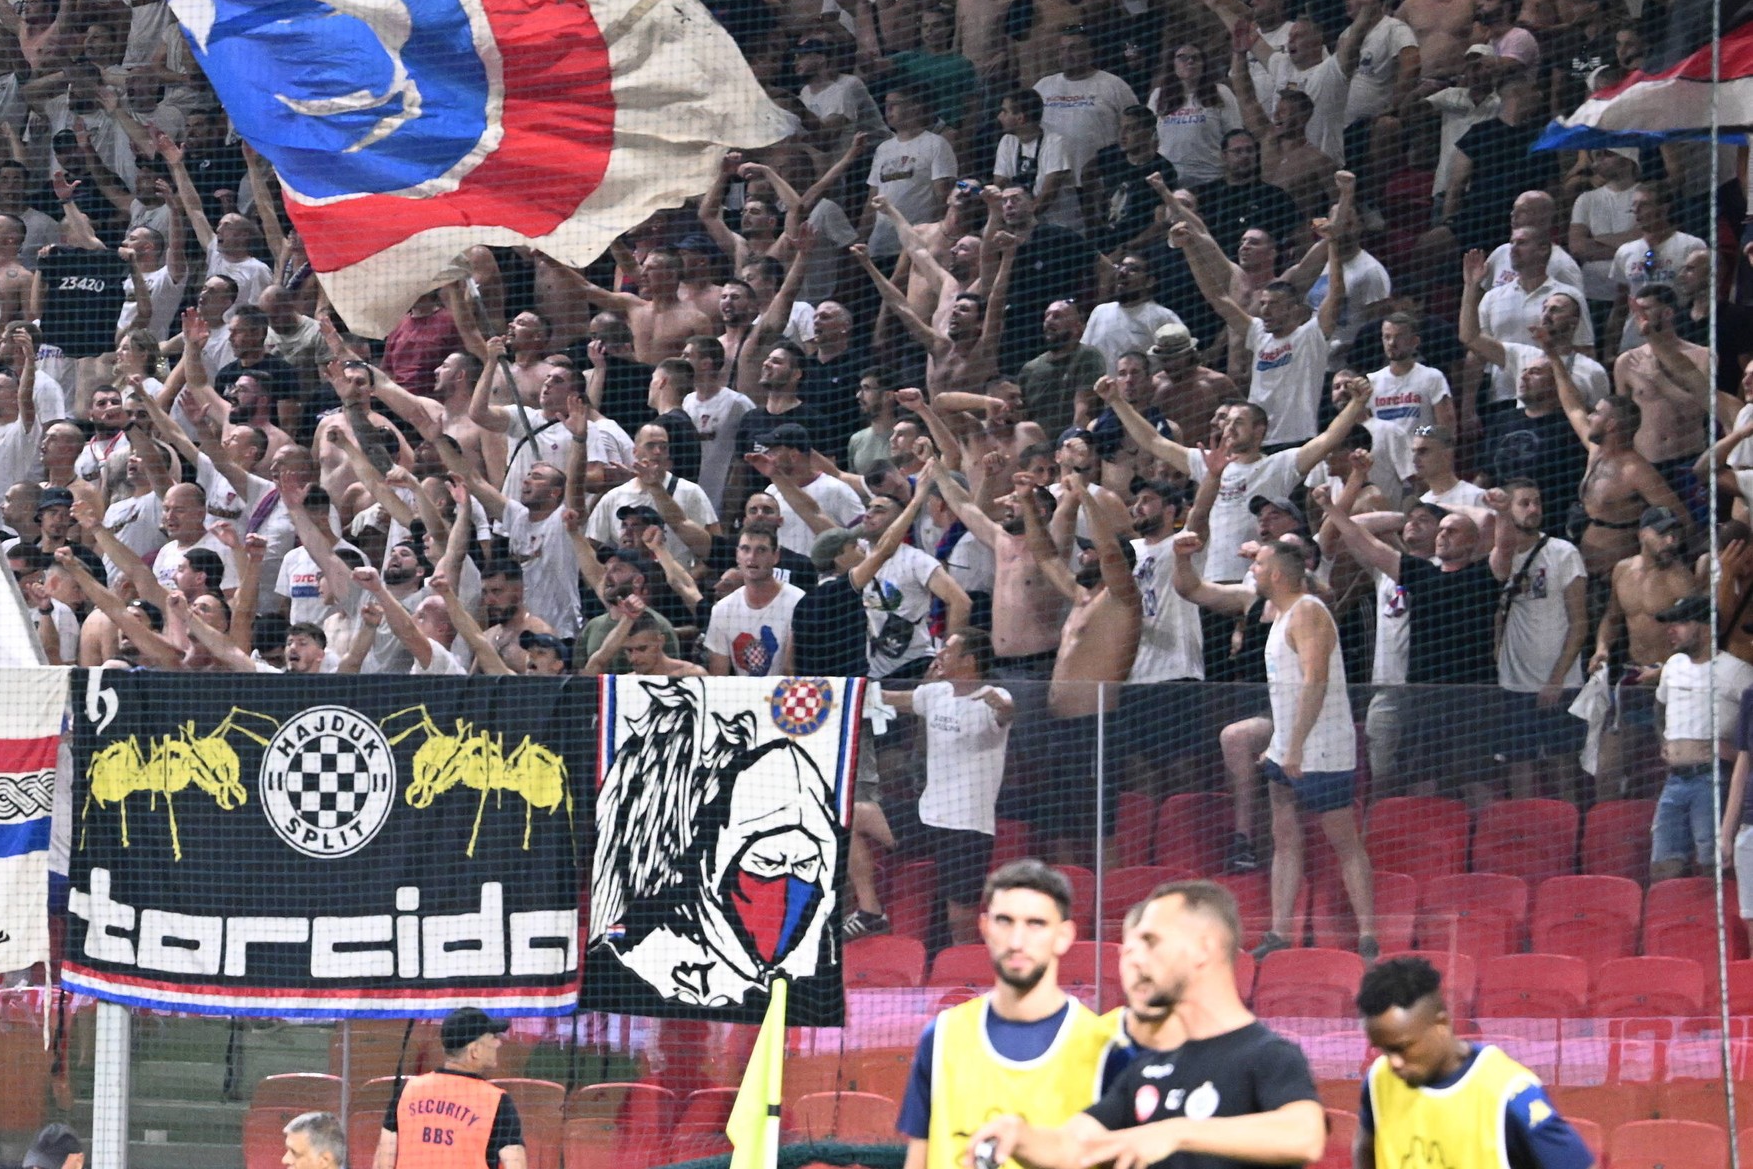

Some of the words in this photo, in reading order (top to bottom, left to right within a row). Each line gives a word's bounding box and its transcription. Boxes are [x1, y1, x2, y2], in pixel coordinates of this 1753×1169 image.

[58, 276, 106, 293] 23420
[1375, 391, 1422, 407] torcida
[276, 715, 380, 759] HAJDUK
[285, 817, 364, 849] SPLIT
[68, 867, 579, 979] torcida
[409, 1099, 480, 1127] SECURITY
[422, 1127, 455, 1145] BBS
